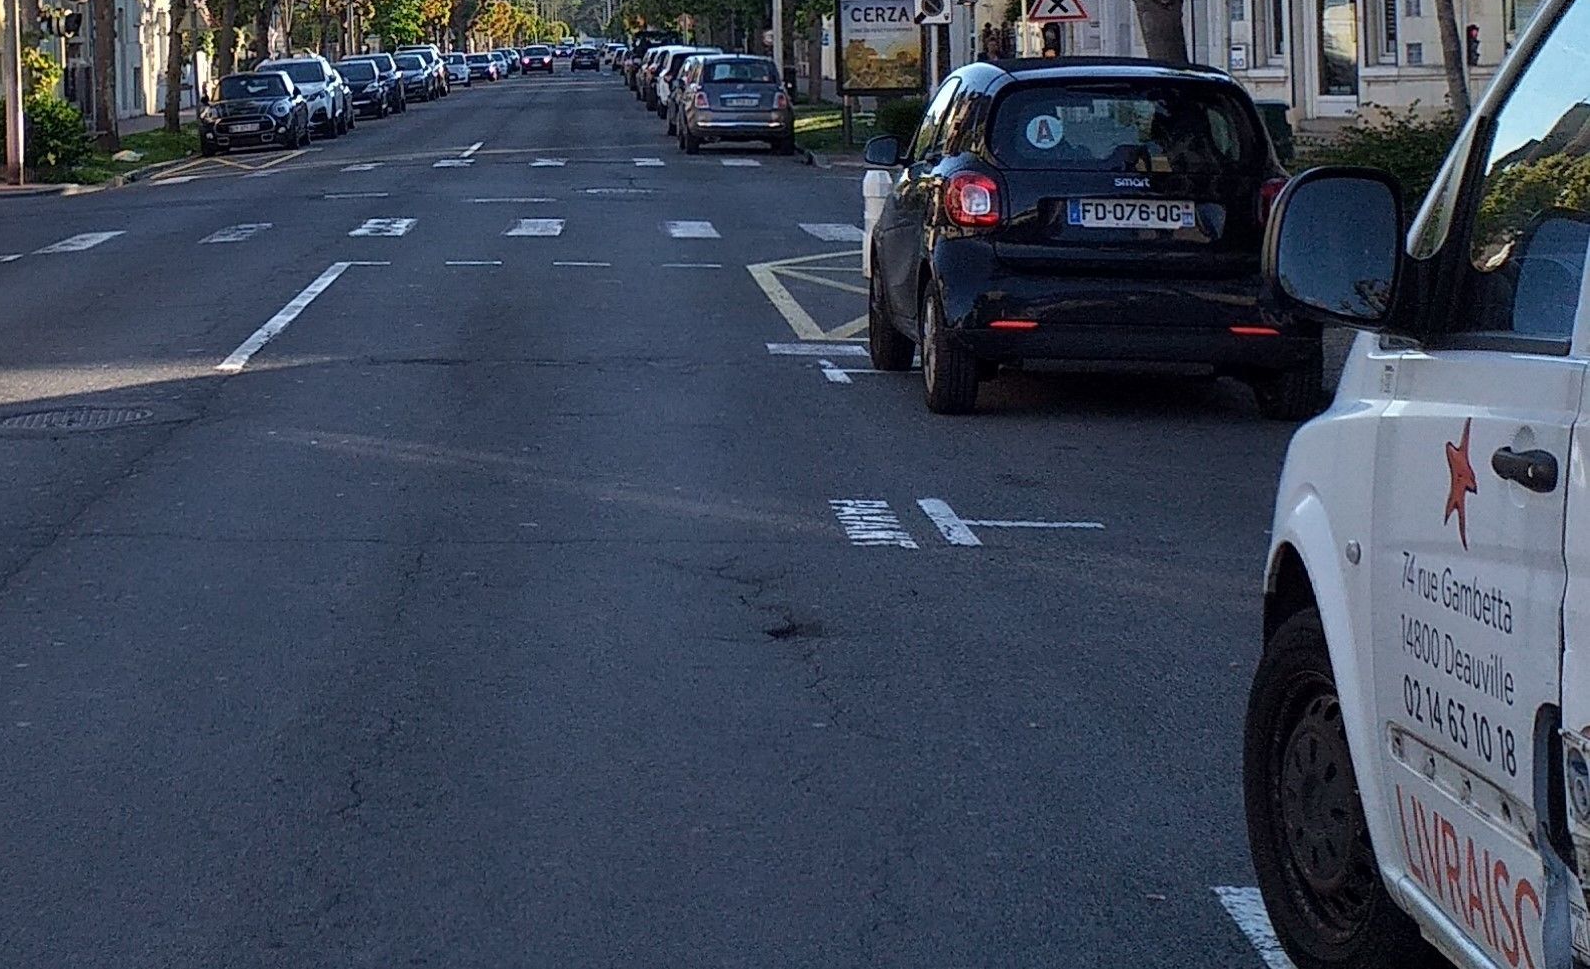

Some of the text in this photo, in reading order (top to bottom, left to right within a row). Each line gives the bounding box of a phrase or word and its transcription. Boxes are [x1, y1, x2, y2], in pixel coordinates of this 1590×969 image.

[850, 6, 910, 23] CERZA
[1036, 119, 1055, 144] A
[1114, 177, 1150, 188] smart
[1081, 202, 1181, 223] FD-076-QG
[1401, 550, 1514, 634] 74 rue Gambetta
[1401, 613, 1514, 707] 14800 Deauville
[1403, 673, 1517, 778] 02 14 63 10 18
